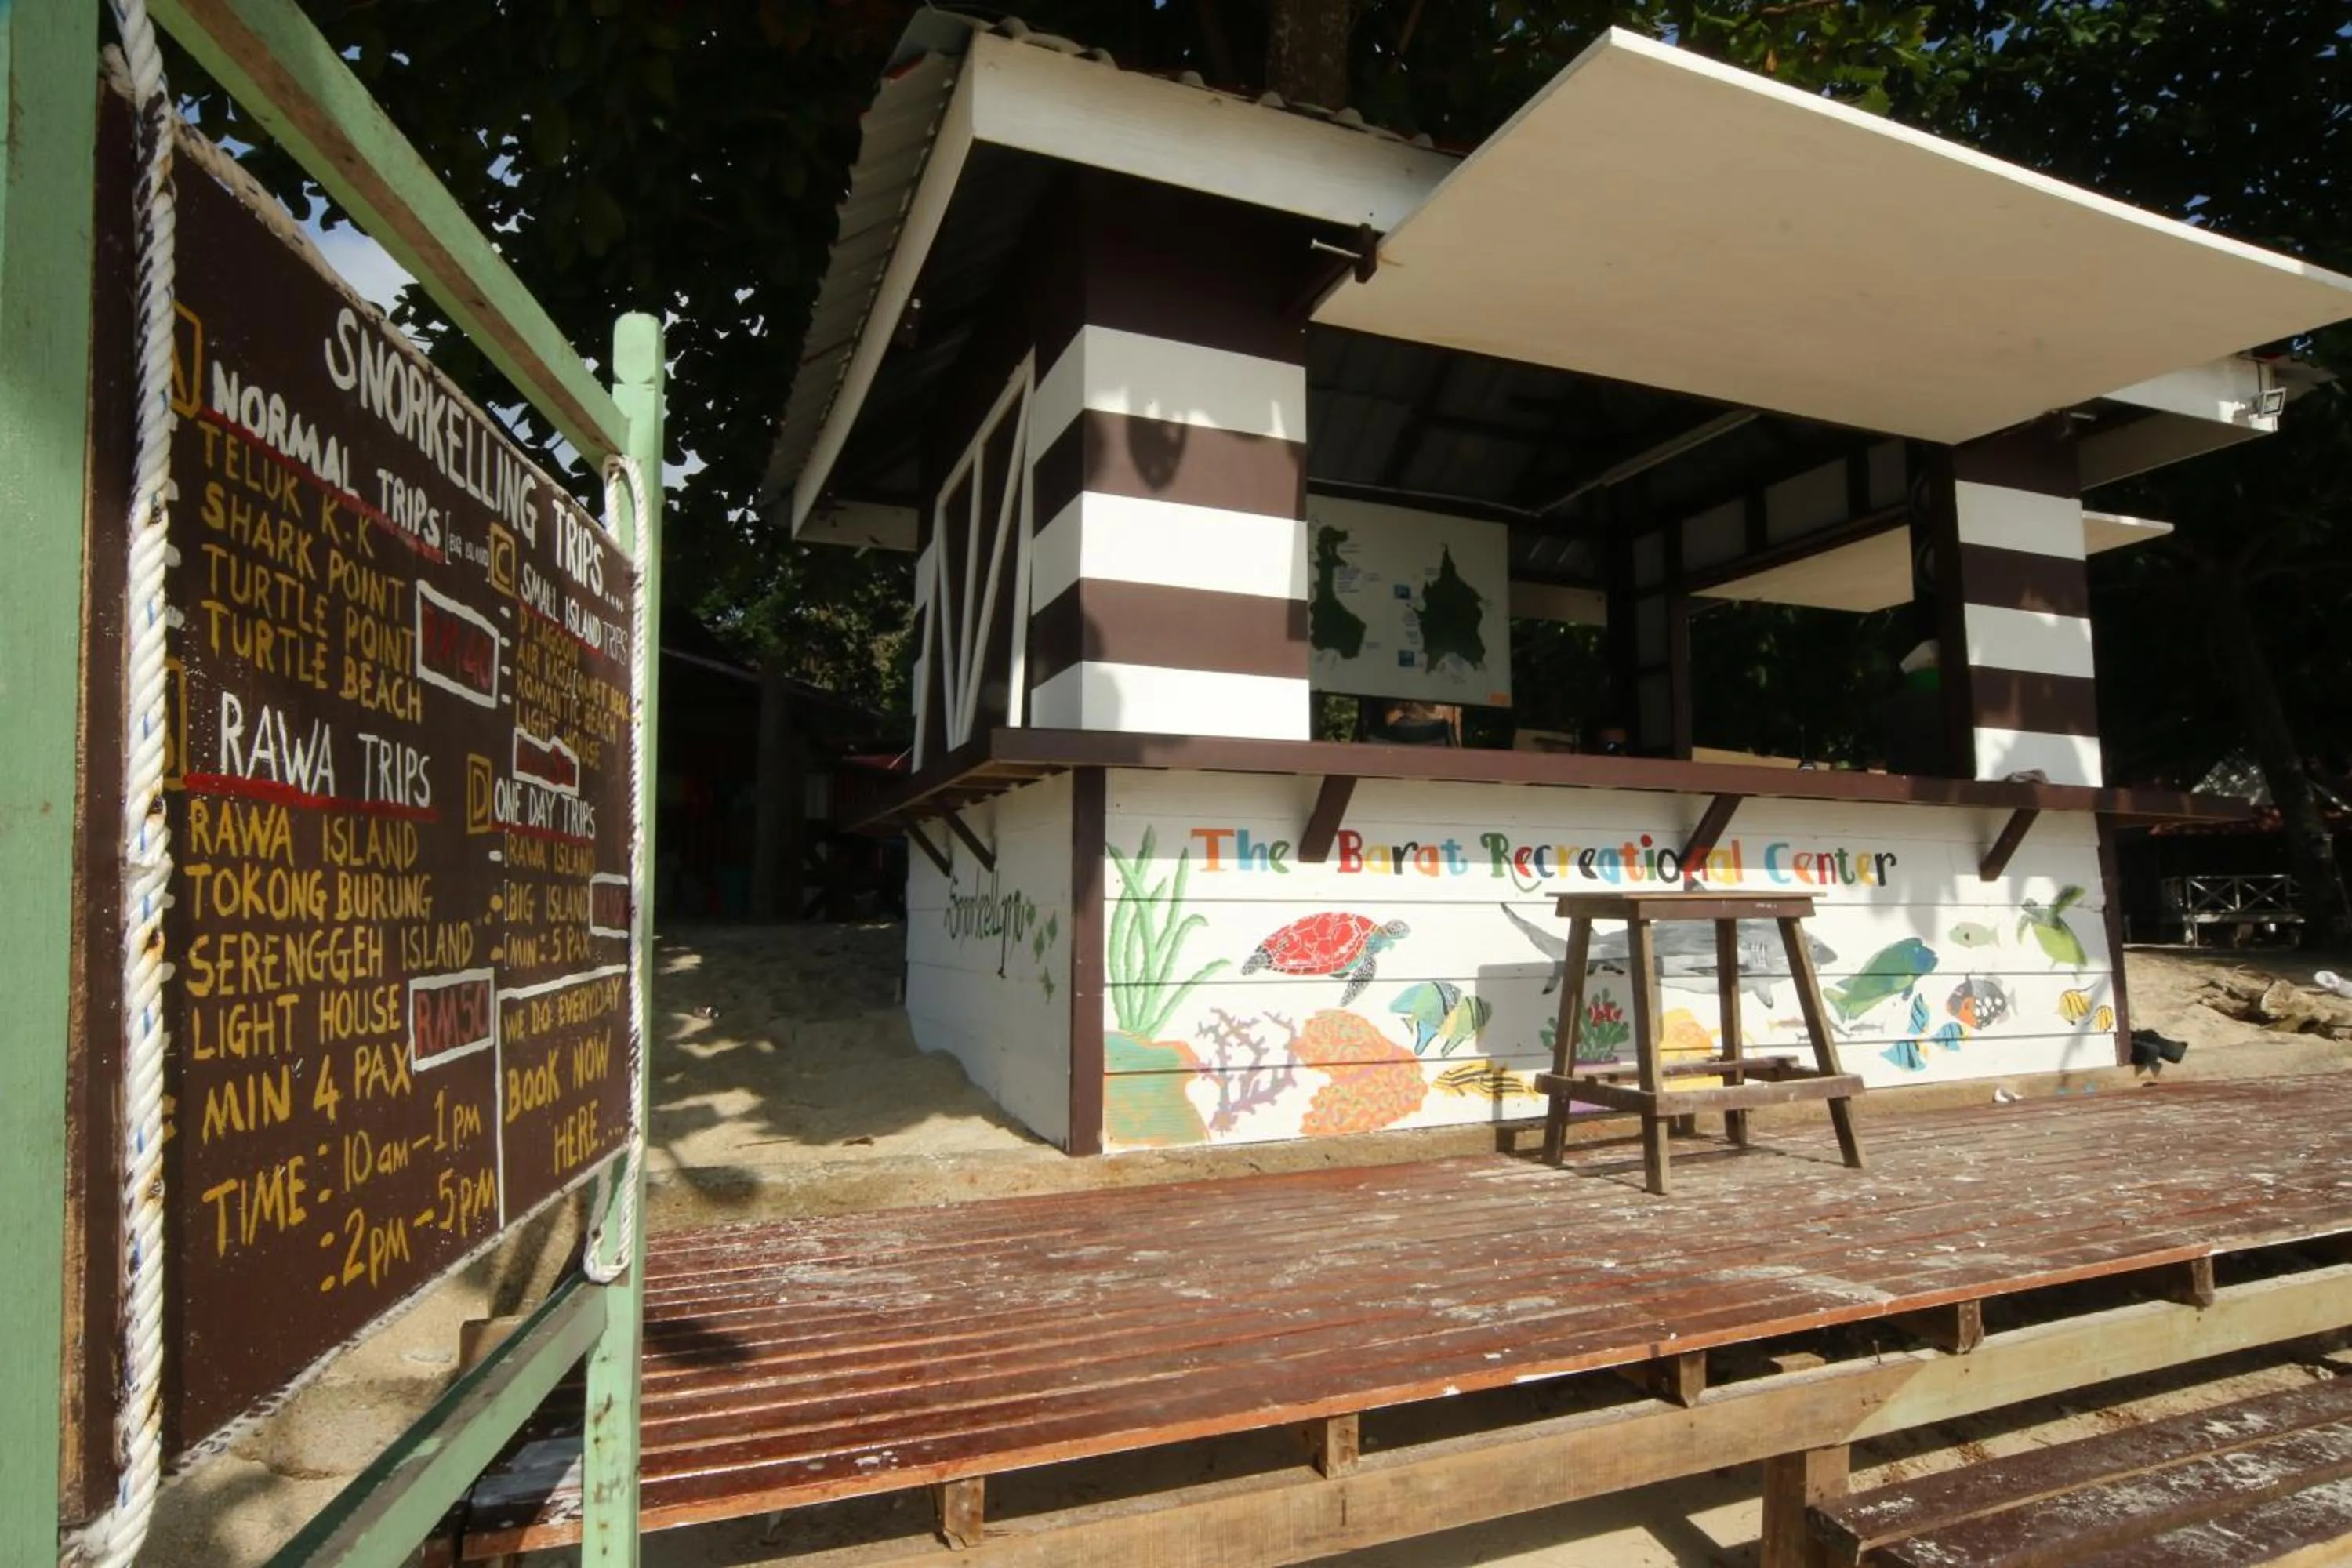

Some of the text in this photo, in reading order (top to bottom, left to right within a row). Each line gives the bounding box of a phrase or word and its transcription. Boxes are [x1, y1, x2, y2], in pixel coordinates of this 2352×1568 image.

[212, 360, 361, 500] NORMAL
[376, 467, 441, 548] TRIPS
[325, 308, 539, 548] SNORKELLING
[198, 420, 302, 518] TELUK
[201, 481, 406, 621] SHARK POINT
[201, 543, 416, 676] TURTLE POINT
[521, 562, 560, 623] SMALL
[565, 596, 602, 650] ISLAND
[201, 600, 422, 725] TURTLE BEACH
[220, 692, 335, 797] RAWA
[358, 733, 432, 809] TRIPS
[585, 705, 616, 745] BEACH
[190, 800, 419, 867] RAWA ISLAND
[495, 777, 595, 840] ONE DAY TRIPS
[186, 863, 432, 922] TOKONG BURUNG
[554, 841, 594, 879] ISLAND
[1190, 828, 1898, 892] The Barat Recreational Center
[546, 884, 590, 924] ISLAND
[186, 922, 474, 998] SERENGGEH ISLAND
[567, 925, 591, 963] PAX
[192, 982, 401, 1060] LIGHT HOUSE
[416, 982, 488, 1058] RM50
[504, 1007, 525, 1044] WE
[557, 977, 622, 1028] EVERYDAY
[202, 1040, 412, 1145] MIN 4 PAX
[506, 1029, 612, 1122] BOOK NOW
